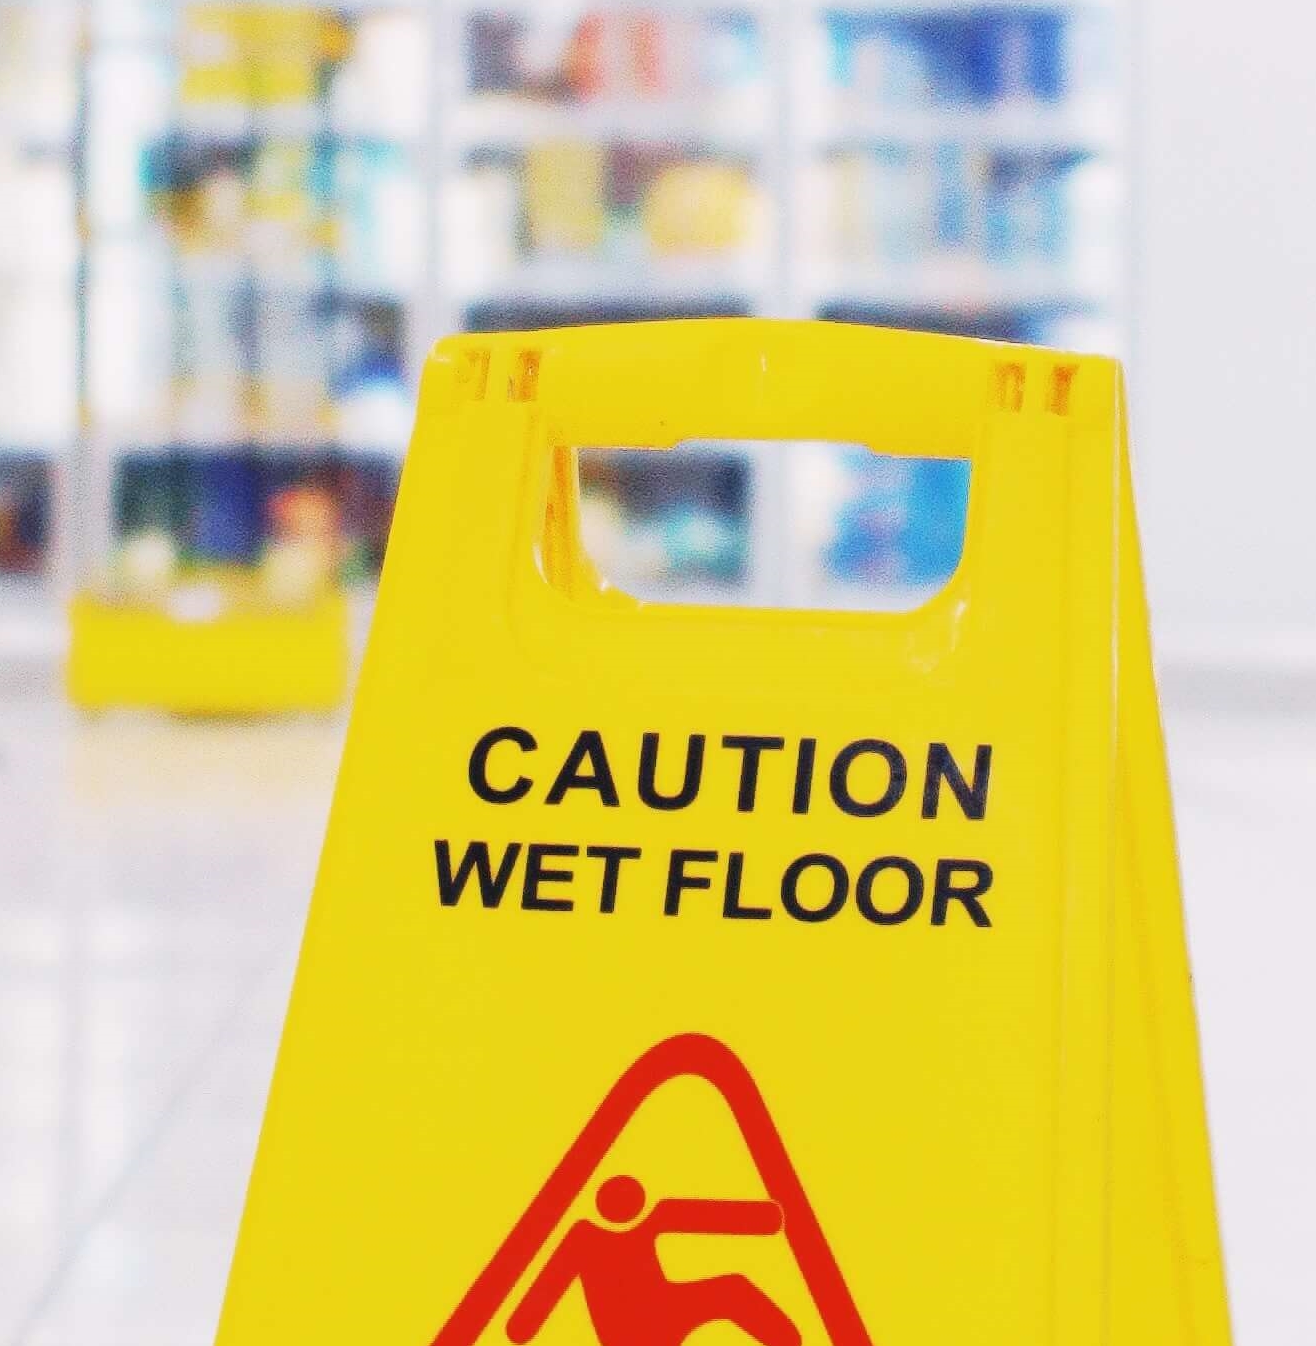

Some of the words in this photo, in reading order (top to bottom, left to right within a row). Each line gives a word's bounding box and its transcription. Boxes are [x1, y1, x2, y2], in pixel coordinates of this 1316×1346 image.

[468, 726, 992, 820] CAUTION
[434, 840, 642, 916] WET
[664, 849, 994, 928] FLOOR
